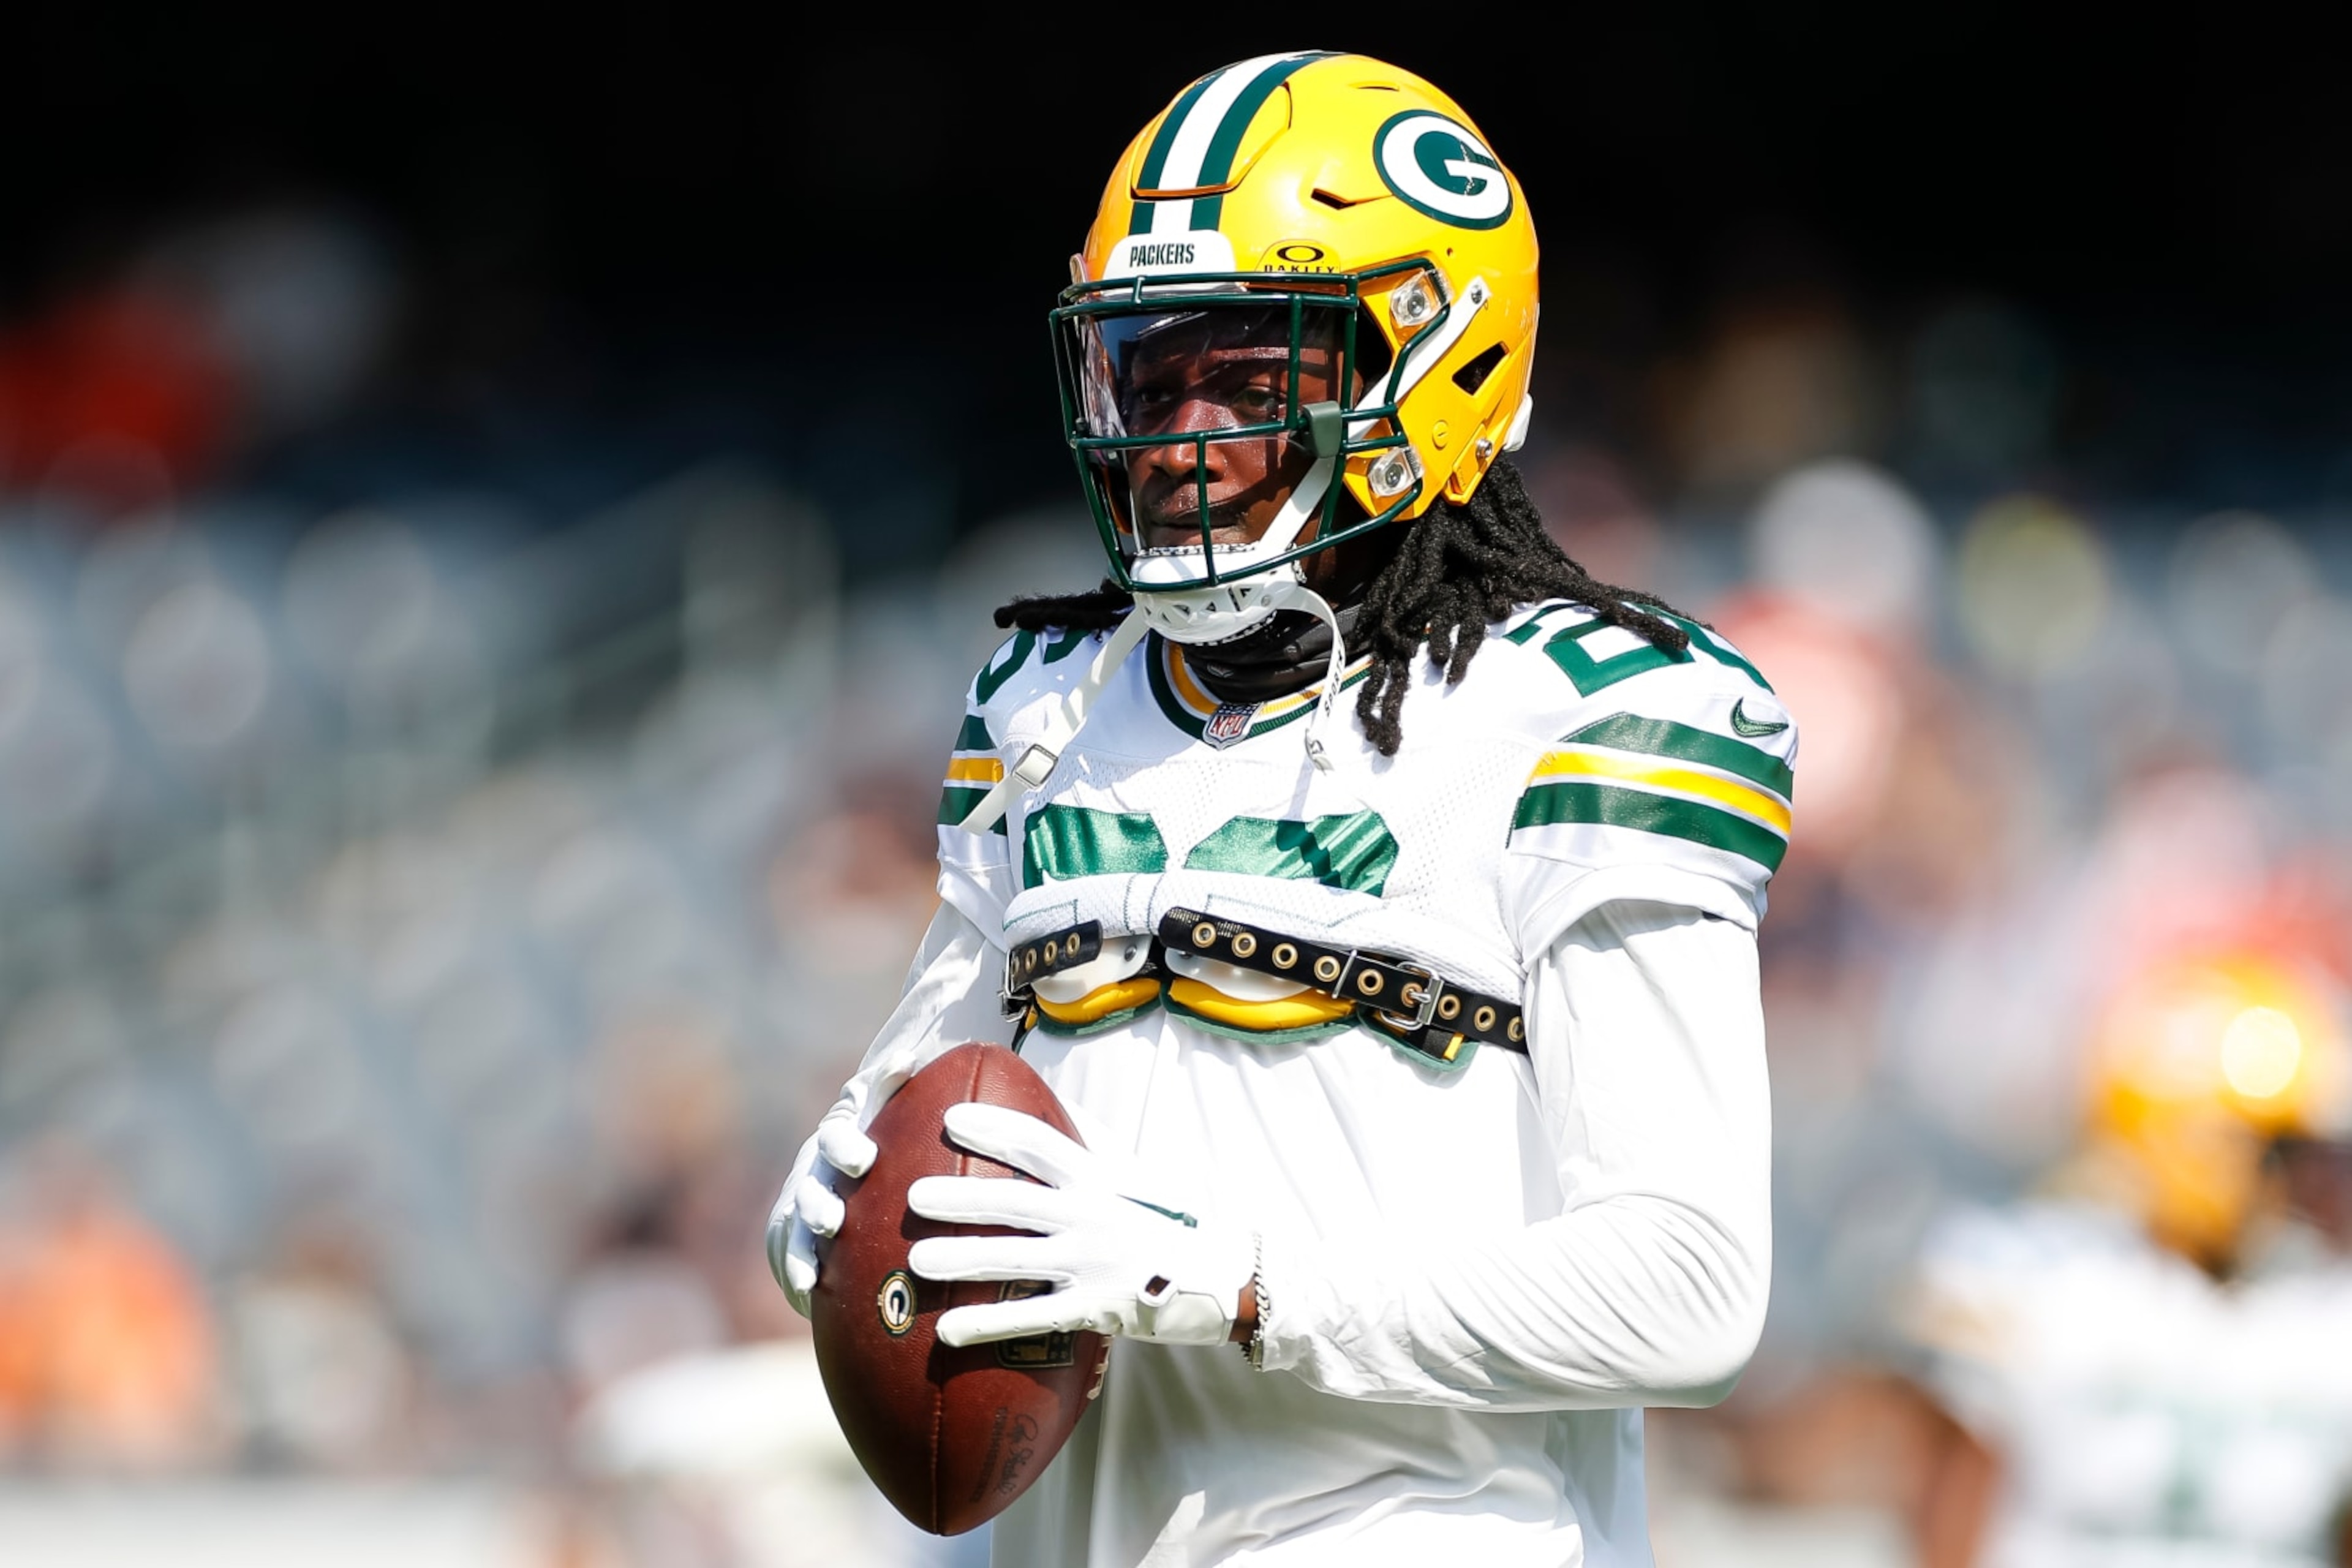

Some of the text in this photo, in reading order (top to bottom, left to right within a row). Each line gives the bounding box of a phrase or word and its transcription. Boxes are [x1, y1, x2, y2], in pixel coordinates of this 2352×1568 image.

[1379, 114, 1510, 223] G
[1129, 243, 1195, 268] PACKERS
[1210, 714, 1247, 737] NFL
